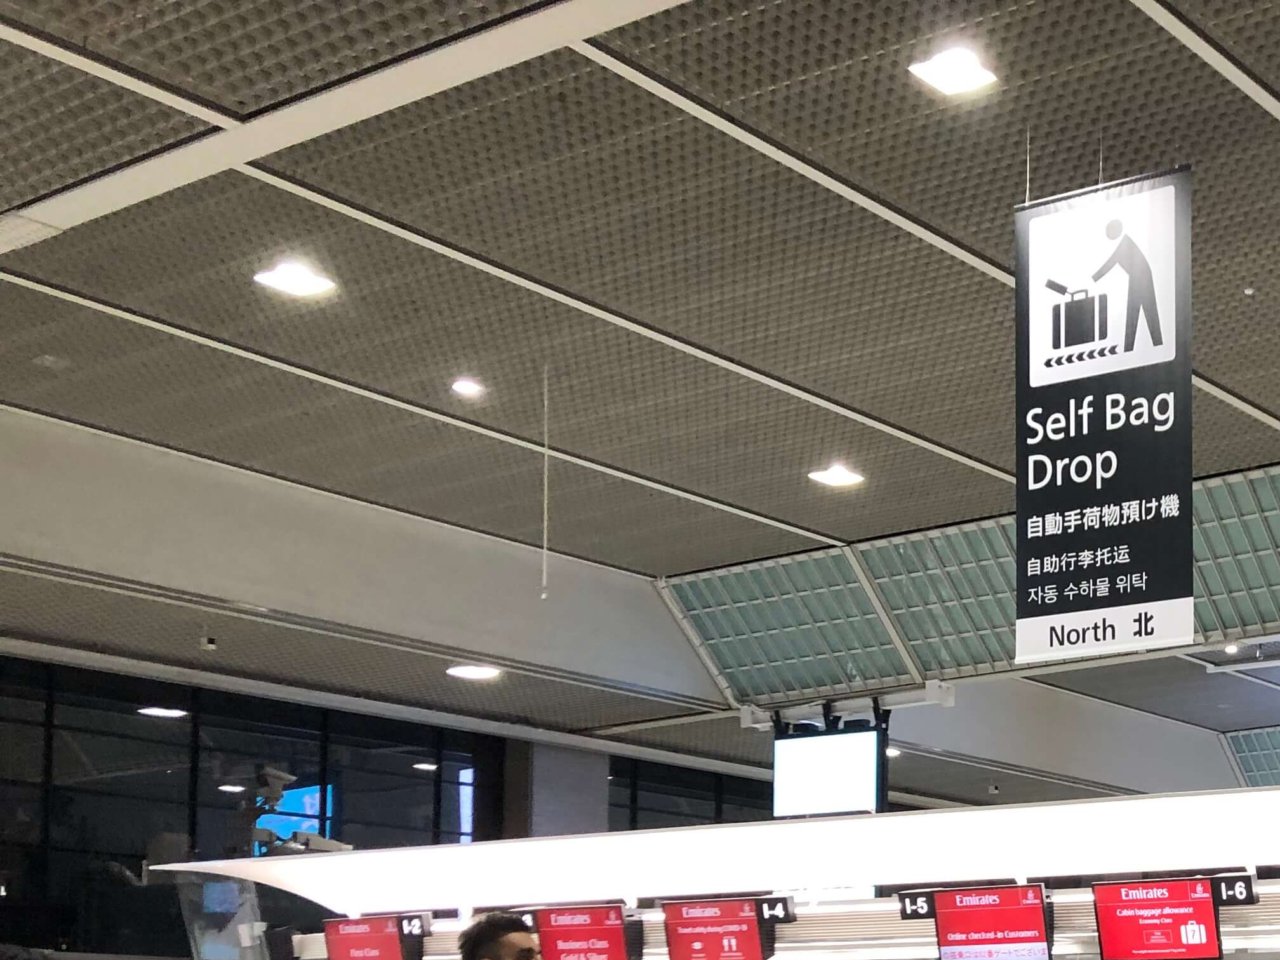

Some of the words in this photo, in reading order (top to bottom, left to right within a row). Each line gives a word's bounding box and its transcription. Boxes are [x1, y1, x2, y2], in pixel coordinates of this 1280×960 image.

[1026, 395, 1094, 445] Self
[1105, 389, 1175, 434] Bag
[1027, 448, 1118, 491] Drop
[1026, 493, 1180, 539] 自動手荷物預け機
[1026, 545, 1131, 576] 自助行李托运
[1027, 584, 1060, 605] 자동
[1063, 578, 1111, 601] 수하물
[1115, 572, 1148, 596] 위탁
[1048, 617, 1117, 648] North
[1132, 611, 1155, 638] 北
[955, 893, 1000, 907] Emirates
[1120, 887, 1169, 901] Emirates
[1220, 881, 1247, 900] I-6
[682, 906, 722, 918] Emirates
[762, 902, 785, 919] I-4
[904, 897, 929, 914] I-5
[550, 913, 591, 925] Emirates
